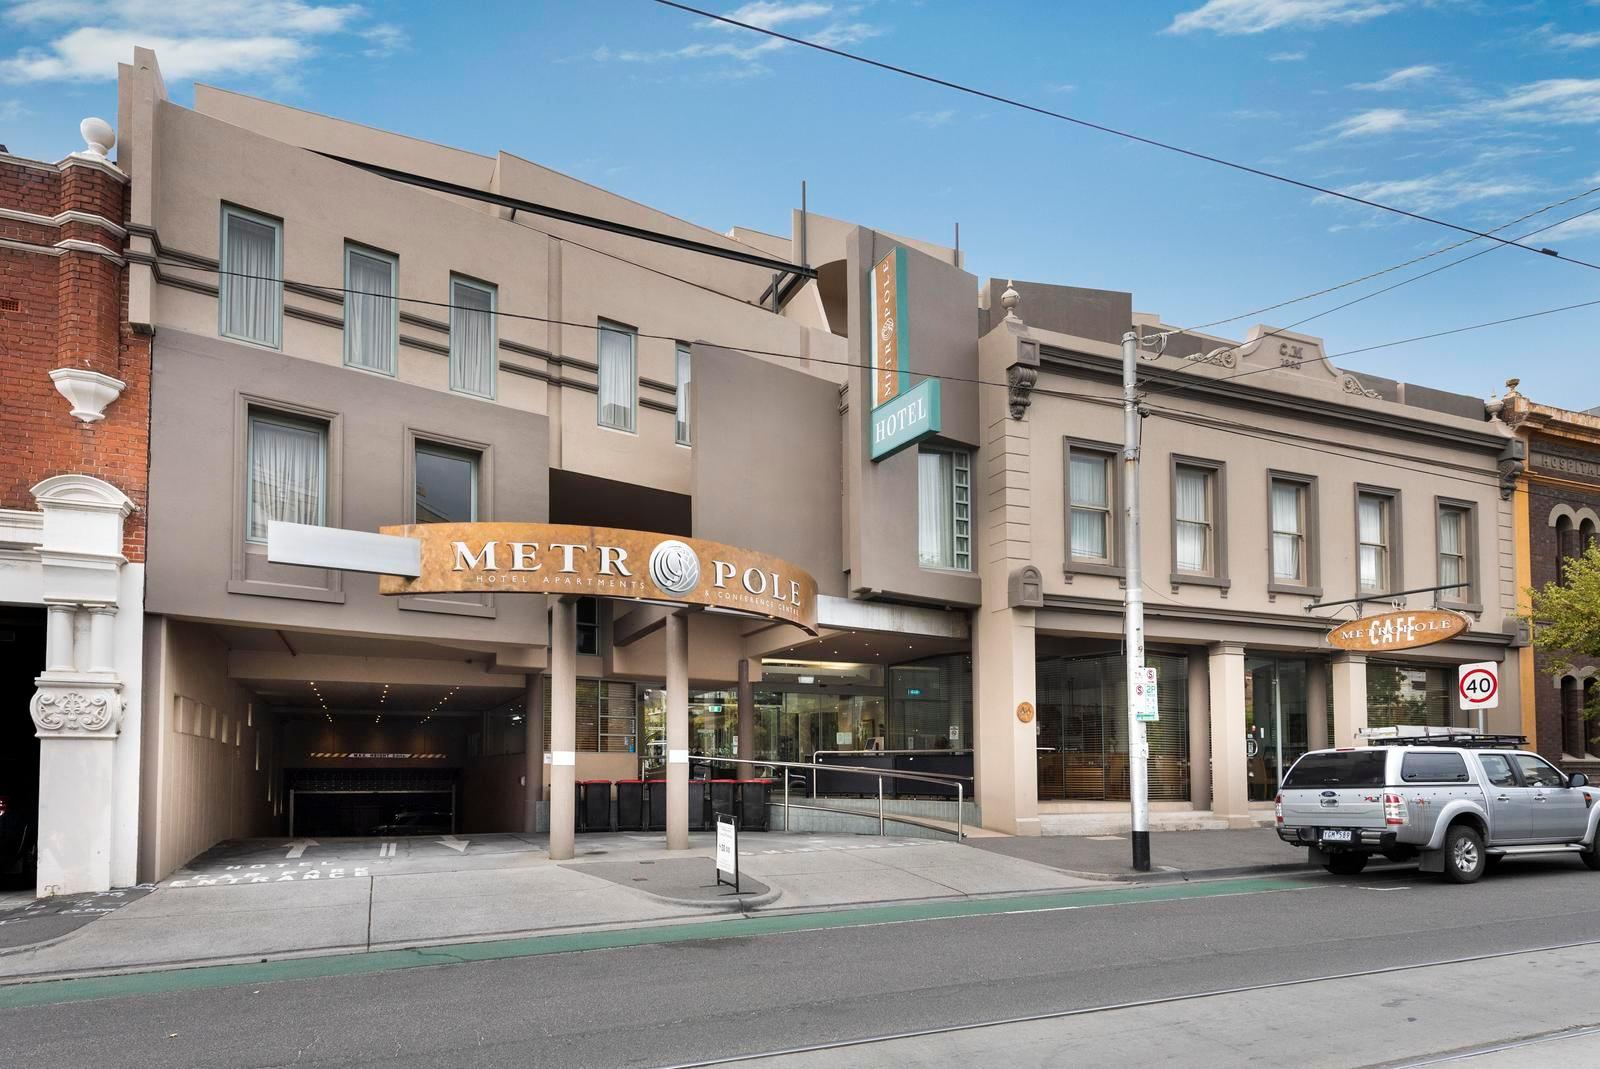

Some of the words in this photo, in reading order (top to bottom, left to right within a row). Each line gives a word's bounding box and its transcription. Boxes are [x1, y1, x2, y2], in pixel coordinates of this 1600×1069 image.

[875, 399, 927, 444] HOTEL
[476, 575, 528, 583] HOTEL
[543, 576, 645, 590] APARTMENTS
[718, 591, 774, 608] CONFERENCE
[1370, 616, 1416, 645] CAFE
[1466, 678, 1491, 693] 40
[225, 861, 335, 871] HOTEL
